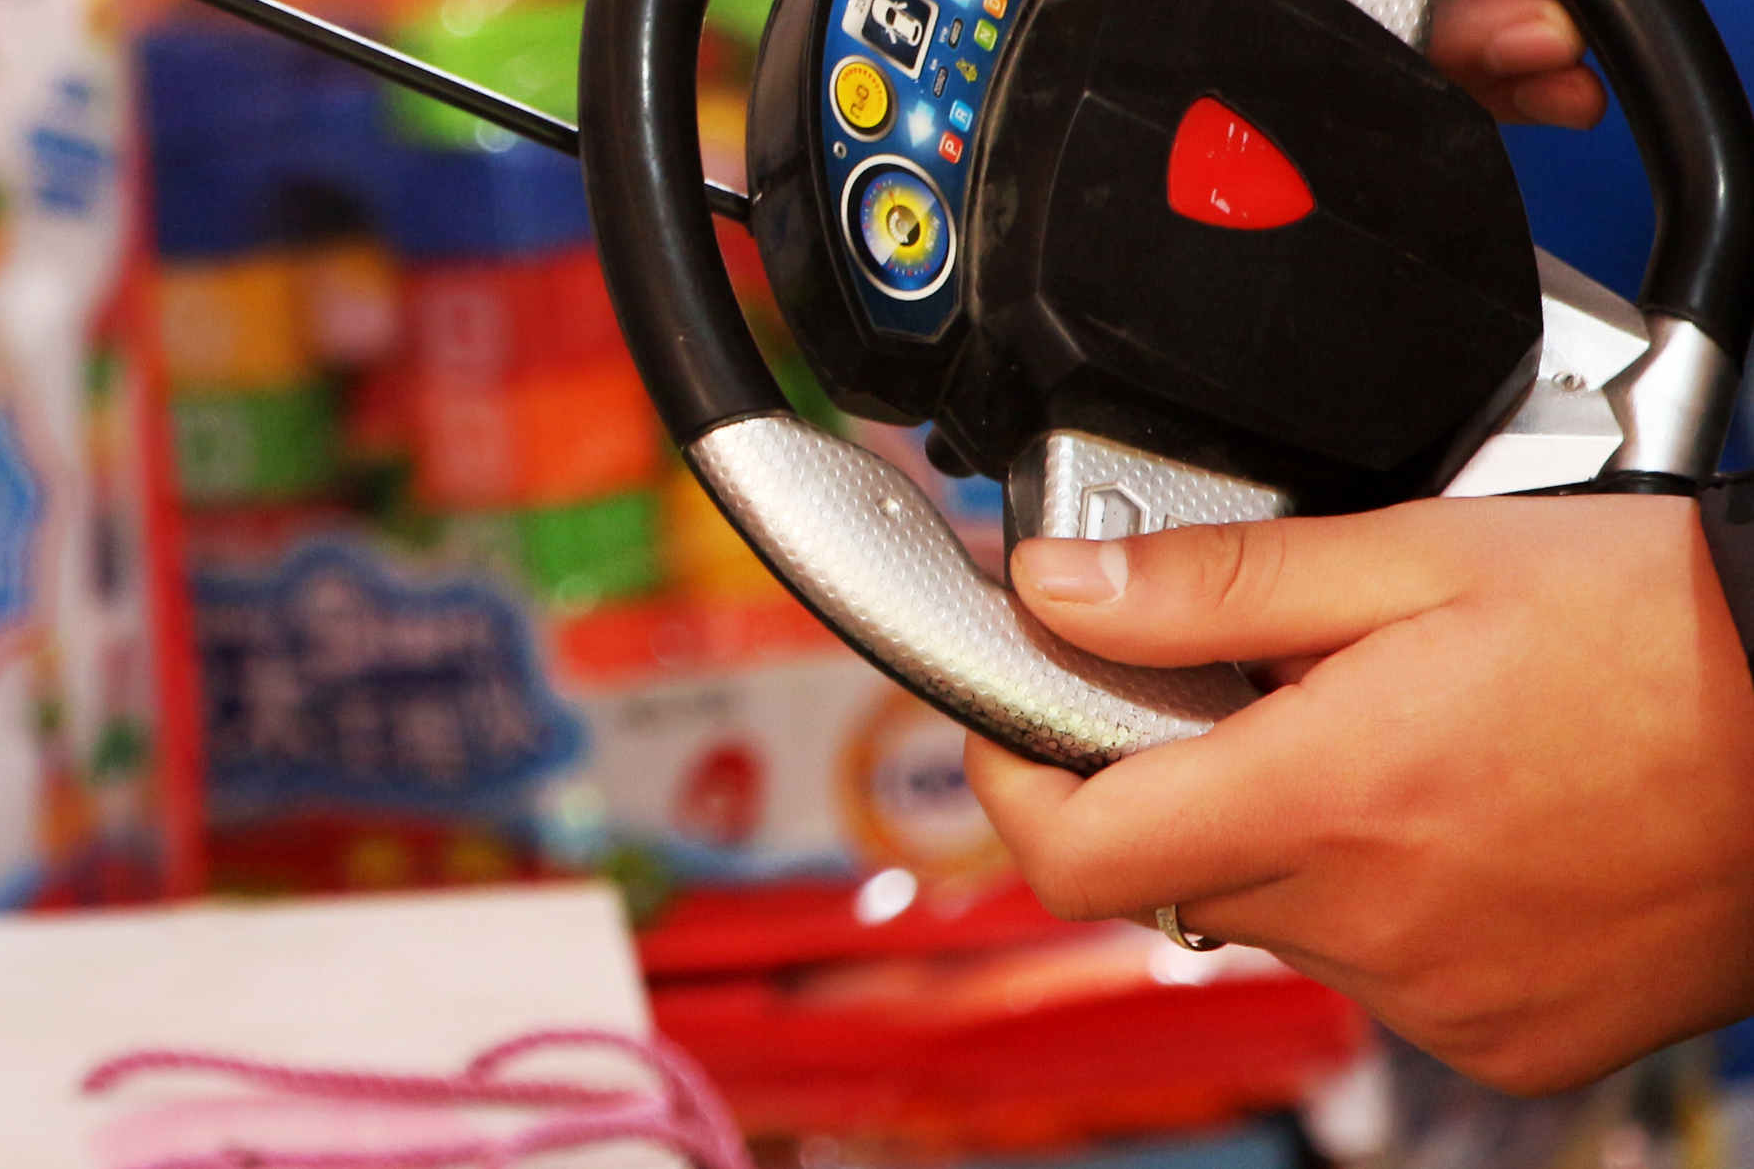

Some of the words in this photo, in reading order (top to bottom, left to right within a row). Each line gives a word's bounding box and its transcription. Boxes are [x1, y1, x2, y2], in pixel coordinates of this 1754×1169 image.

[944, 139, 958, 156] P
[954, 106, 969, 123] R
[978, 26, 993, 41] N
